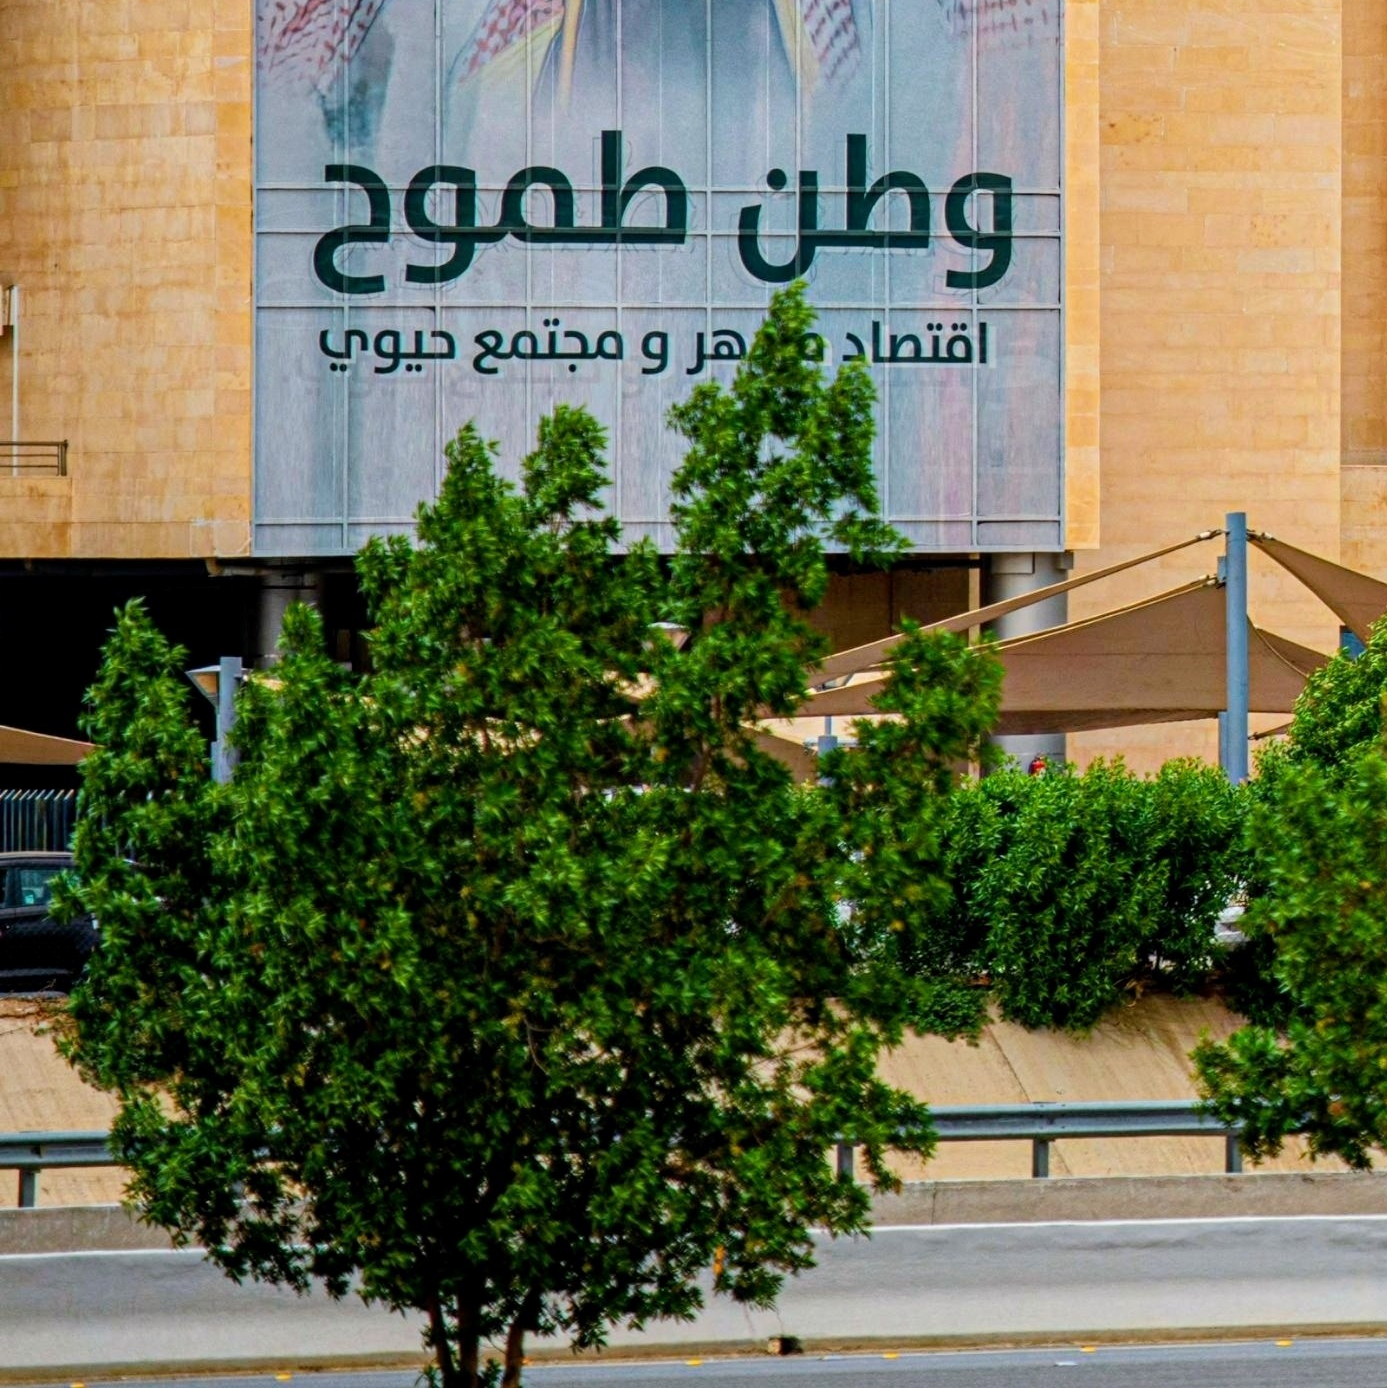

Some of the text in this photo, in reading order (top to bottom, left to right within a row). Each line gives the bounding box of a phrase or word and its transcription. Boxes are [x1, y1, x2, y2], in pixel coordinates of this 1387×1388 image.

[313, 129, 1013, 295] وطن طموح
[318, 317, 988, 375] اقتصاد مهر و مجتمع حيوي
